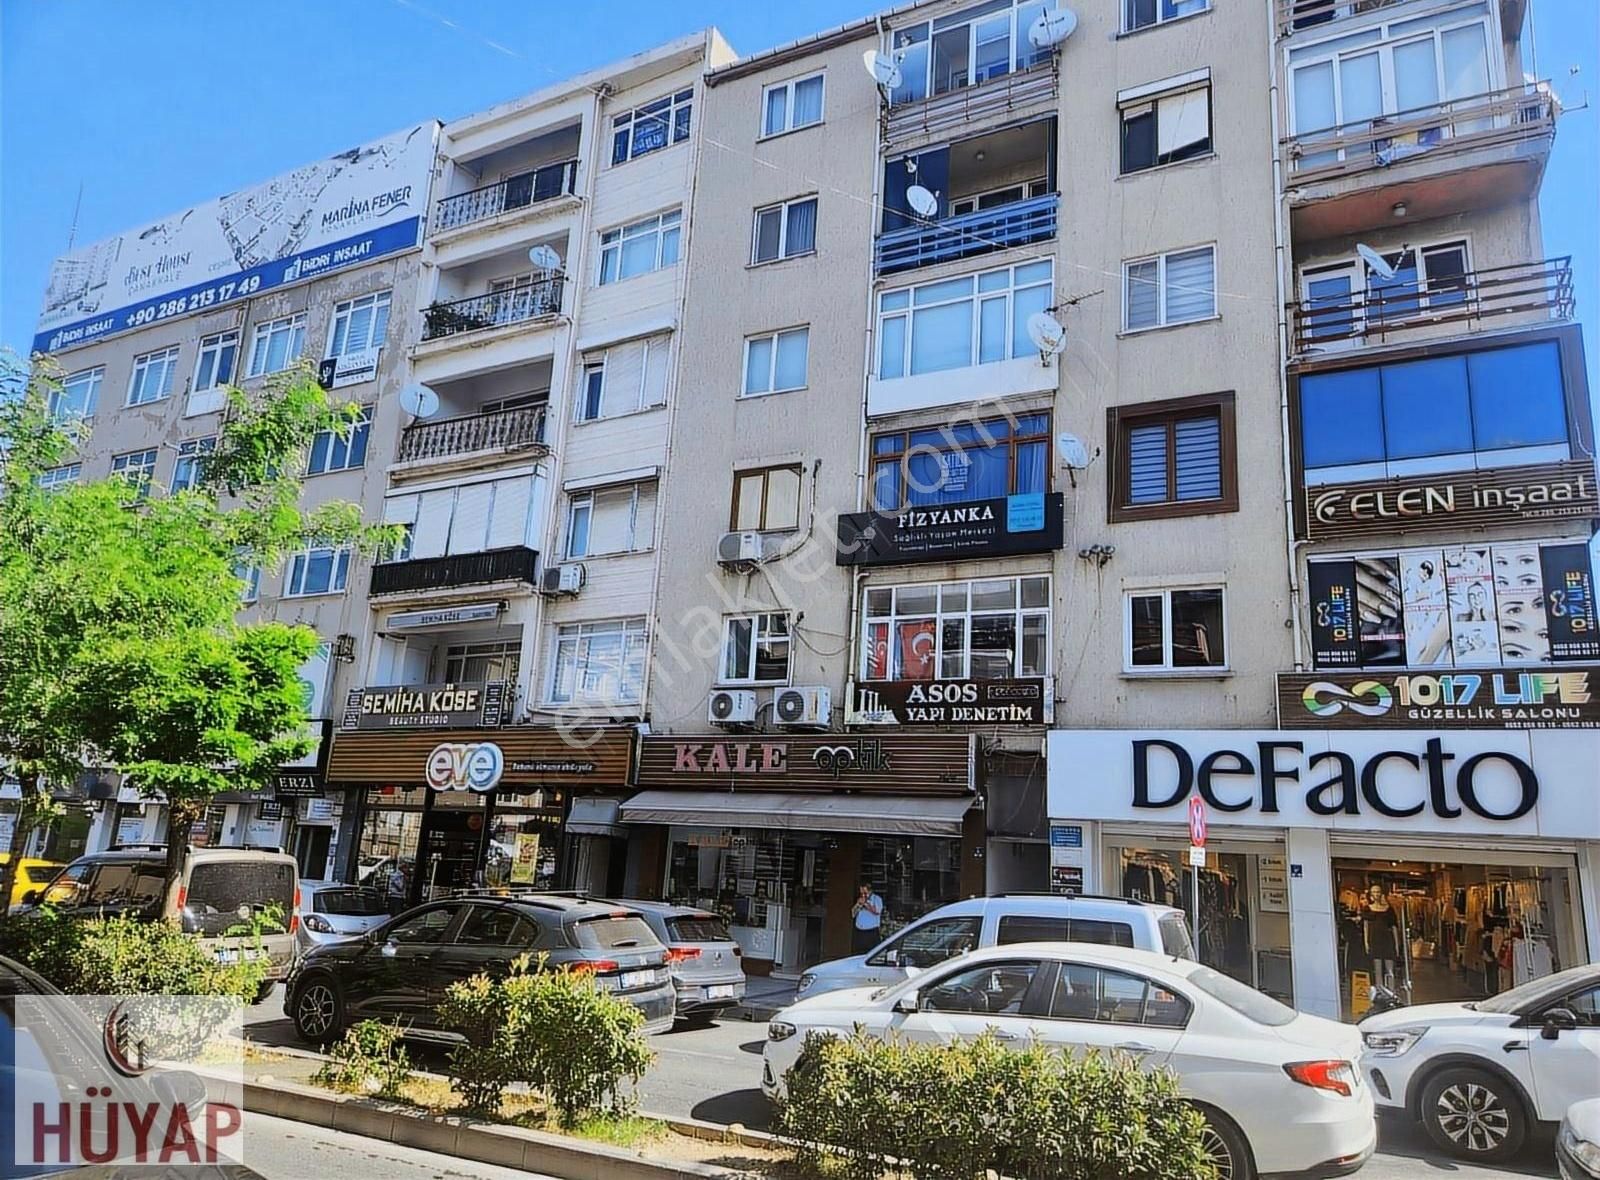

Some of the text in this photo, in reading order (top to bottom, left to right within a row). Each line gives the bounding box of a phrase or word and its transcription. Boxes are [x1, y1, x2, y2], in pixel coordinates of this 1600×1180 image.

[371, 185, 412, 210] FENER
[126, 275, 260, 327] +90 286 213 17 49
[1350, 474, 1590, 518] ELEN inşaat
[898, 505, 995, 528] FİZYANKA
[362, 687, 424, 714] SEMİHA
[430, 683, 479, 712] KÖSE
[906, 684, 977, 703] ASOS
[1394, 672, 1592, 706] 1017 LIFE
[419, 715, 449, 725] STUDIO
[905, 703, 1033, 721] YAPI DENETİM
[1408, 705, 1580, 719] GÜZELLİK SALONU
[427, 744, 503, 790] eve
[672, 739, 892, 777] KALE optik
[1131, 737, 1539, 821] DeFacto
